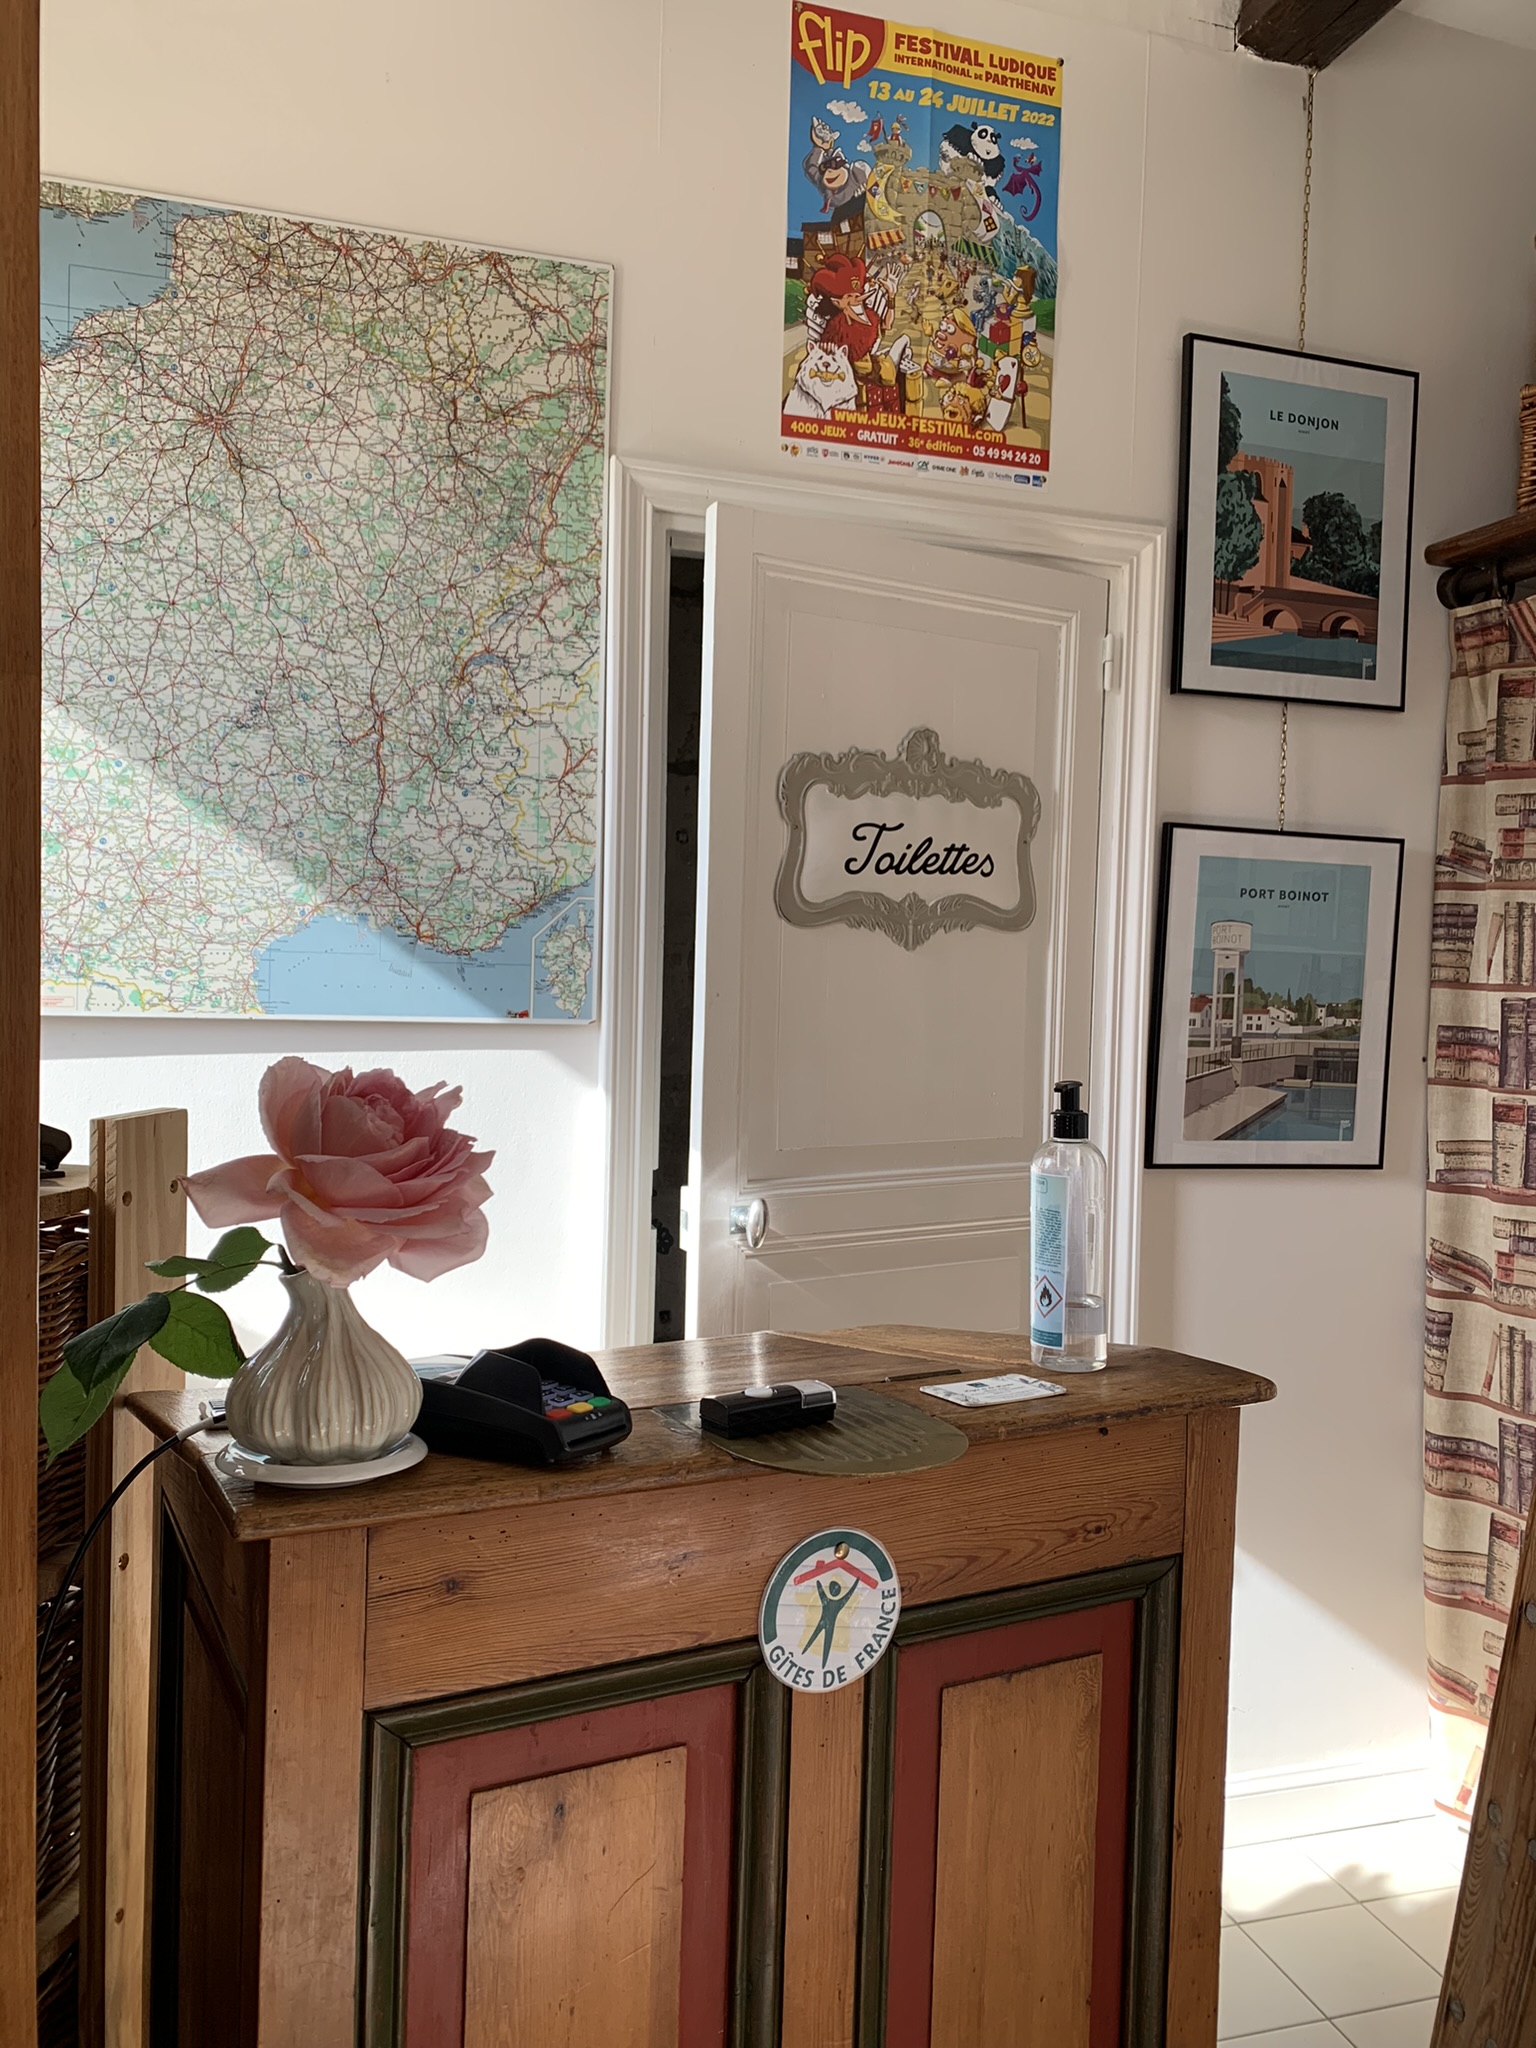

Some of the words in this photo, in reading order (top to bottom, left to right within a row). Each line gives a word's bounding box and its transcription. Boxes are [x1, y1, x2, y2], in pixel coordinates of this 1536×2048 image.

[798, 10, 871, 90] flip
[894, 33, 984, 67] FESTIVAL
[989, 53, 1057, 82] LUDIQUE
[894, 53, 972, 79] INTERNATIONAL
[985, 70, 1056, 96] PARTHENAY
[868, 80, 891, 101] 13
[893, 88, 915, 102] AU
[918, 87, 944, 109] 24
[946, 94, 1020, 122] JUILLET
[1021, 110, 1055, 126] 2022
[790, 421, 819, 435] 4000
[820, 425, 847, 439] JEUX
[857, 429, 899, 446] GRATUIT
[926, 439, 963, 454] édition
[973, 445, 985, 457] 05
[987, 447, 1000, 459] 49
[1001, 449, 1013, 461] 94
[1015, 451, 1027, 463] 24
[1028, 453, 1041, 465] 20
[1270, 409, 1284, 422] LE
[1288, 412, 1339, 431] DONJON
[844, 822, 995, 878] Toilettes
[1240, 887, 1275, 900] PORT
[1279, 890, 1329, 902] BOINOT
[769, 1645, 815, 1688] GÎTES
[823, 1665, 847, 1689] DE
[854, 1588, 896, 1670] FRANCE
